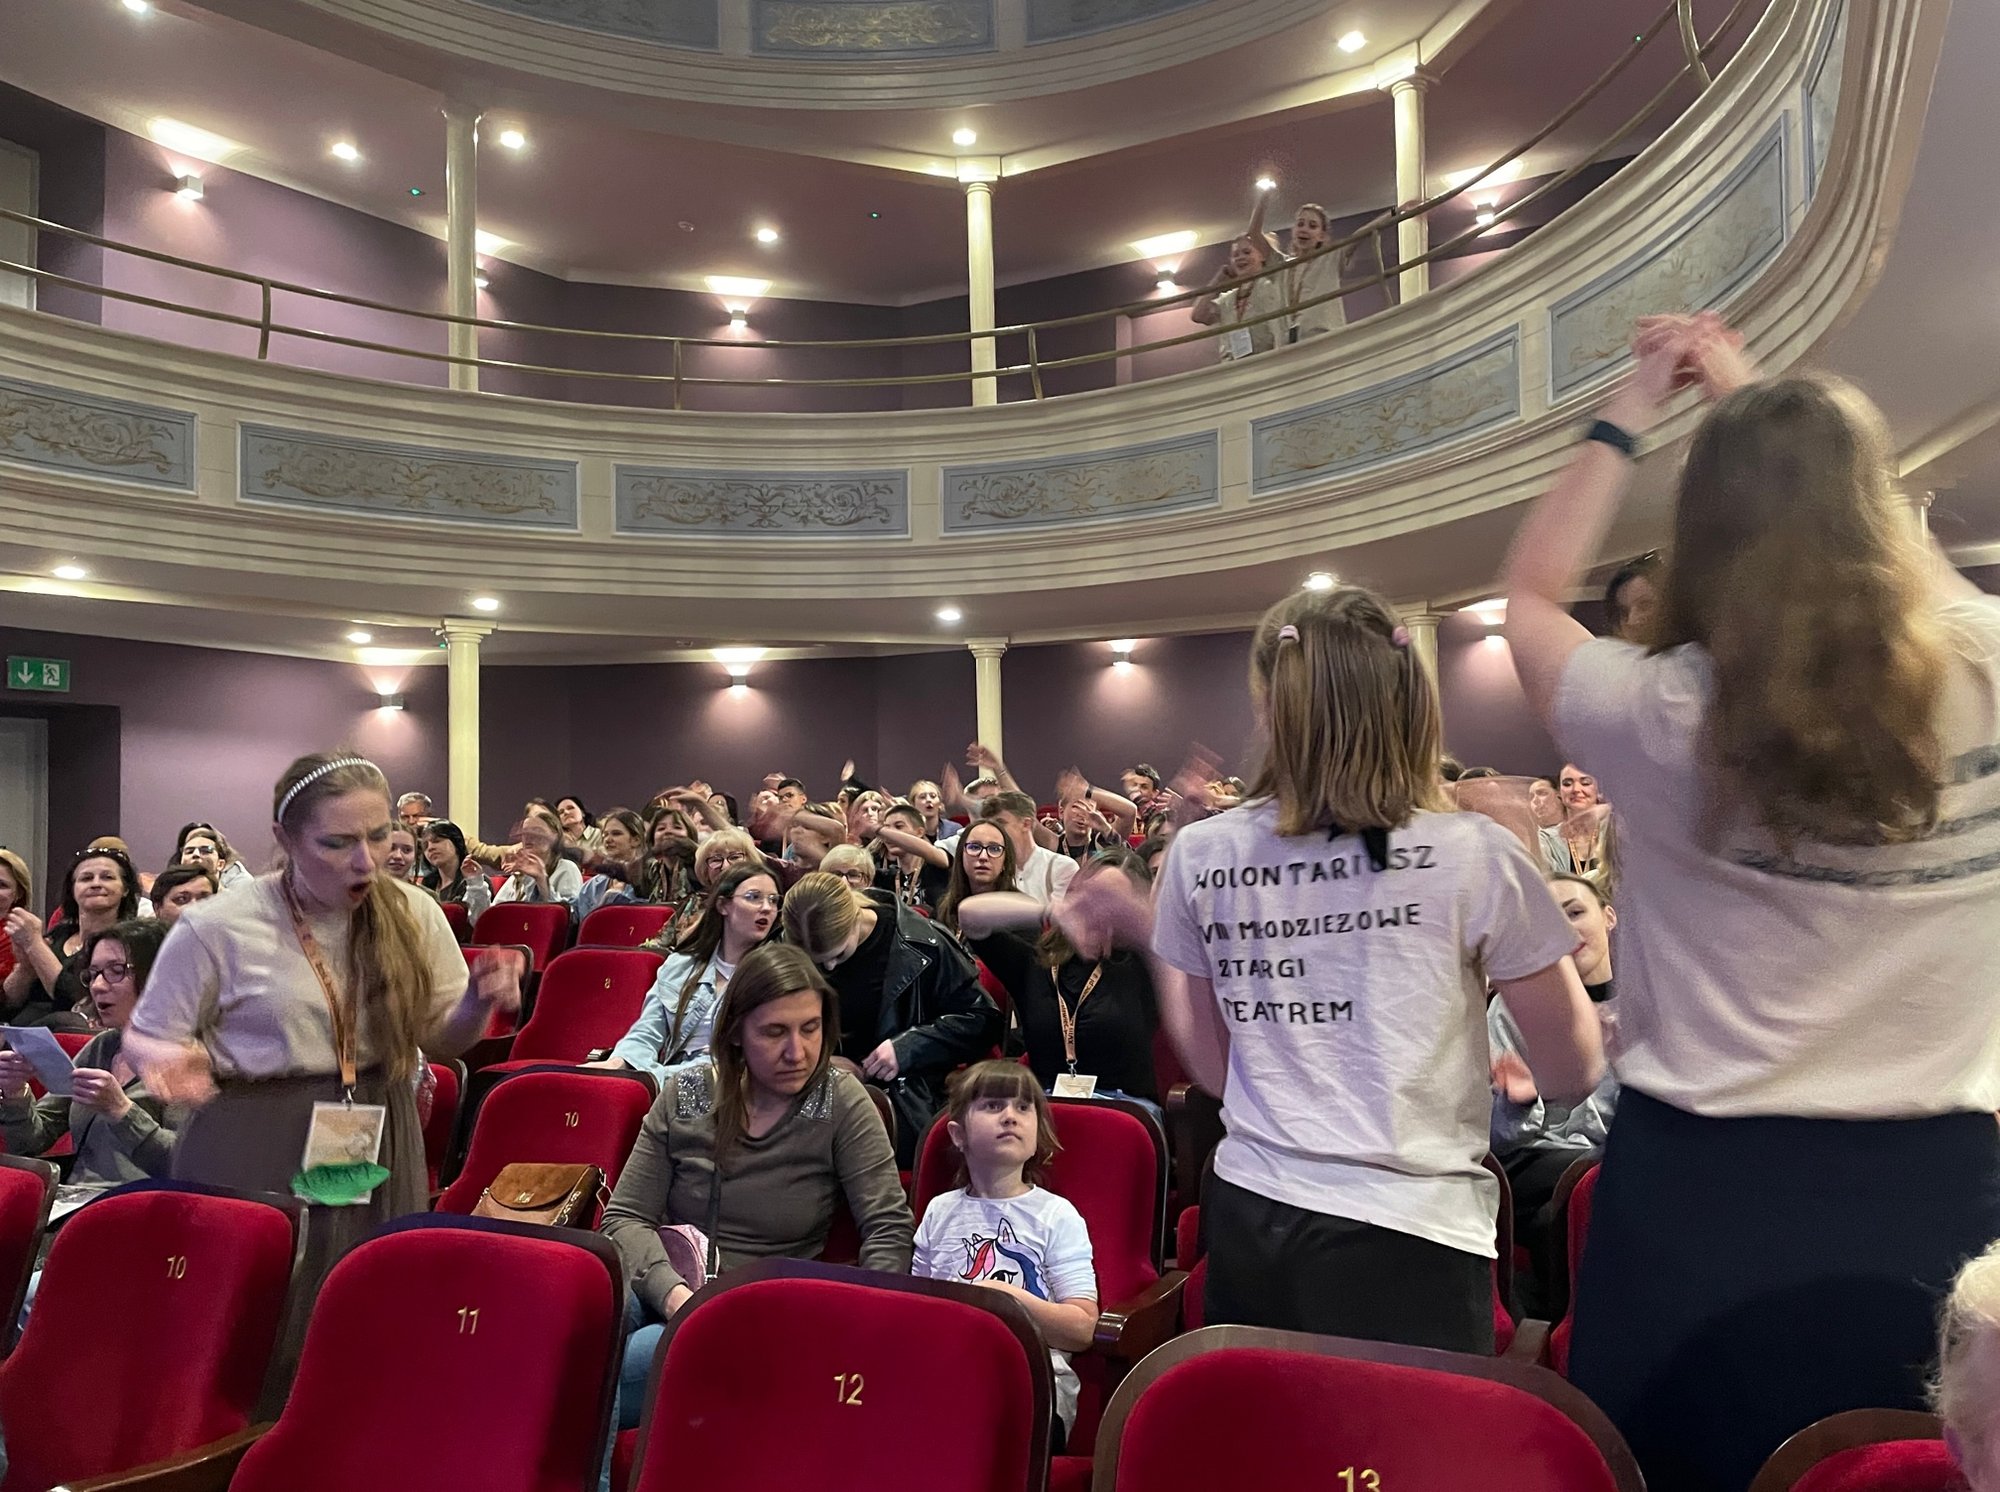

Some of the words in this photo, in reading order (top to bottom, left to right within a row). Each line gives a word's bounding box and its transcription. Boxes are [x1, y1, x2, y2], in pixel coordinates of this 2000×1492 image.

[1192, 845, 1437, 890] WOLONTARISZ
[629, 926, 635, 936] 7
[604, 977, 611, 989] 8
[565, 1111, 580, 1128] 10
[167, 1255, 187, 1279] 10
[457, 1305, 480, 1335] 11
[834, 1372, 864, 1405] 12
[1337, 1466, 1381, 1492] 13
